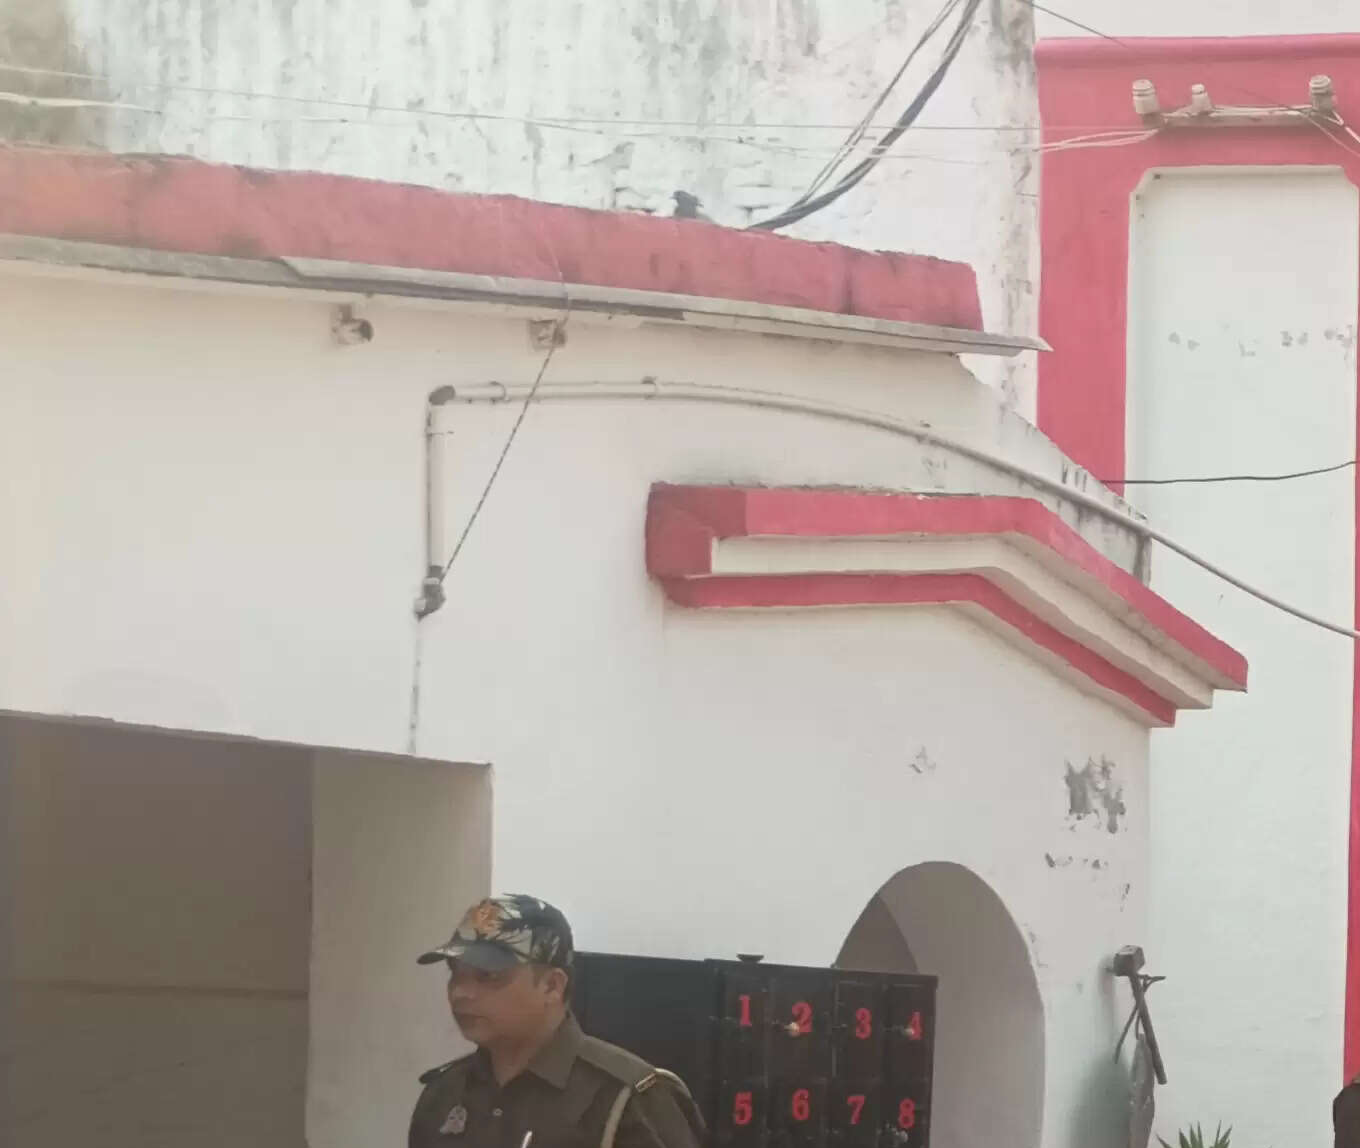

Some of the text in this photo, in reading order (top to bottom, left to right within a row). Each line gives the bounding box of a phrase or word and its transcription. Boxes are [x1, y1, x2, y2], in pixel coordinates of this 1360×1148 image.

[738, 995, 922, 1040] 1 2 3 4
[732, 1089, 916, 1128] 5 6 7 8
